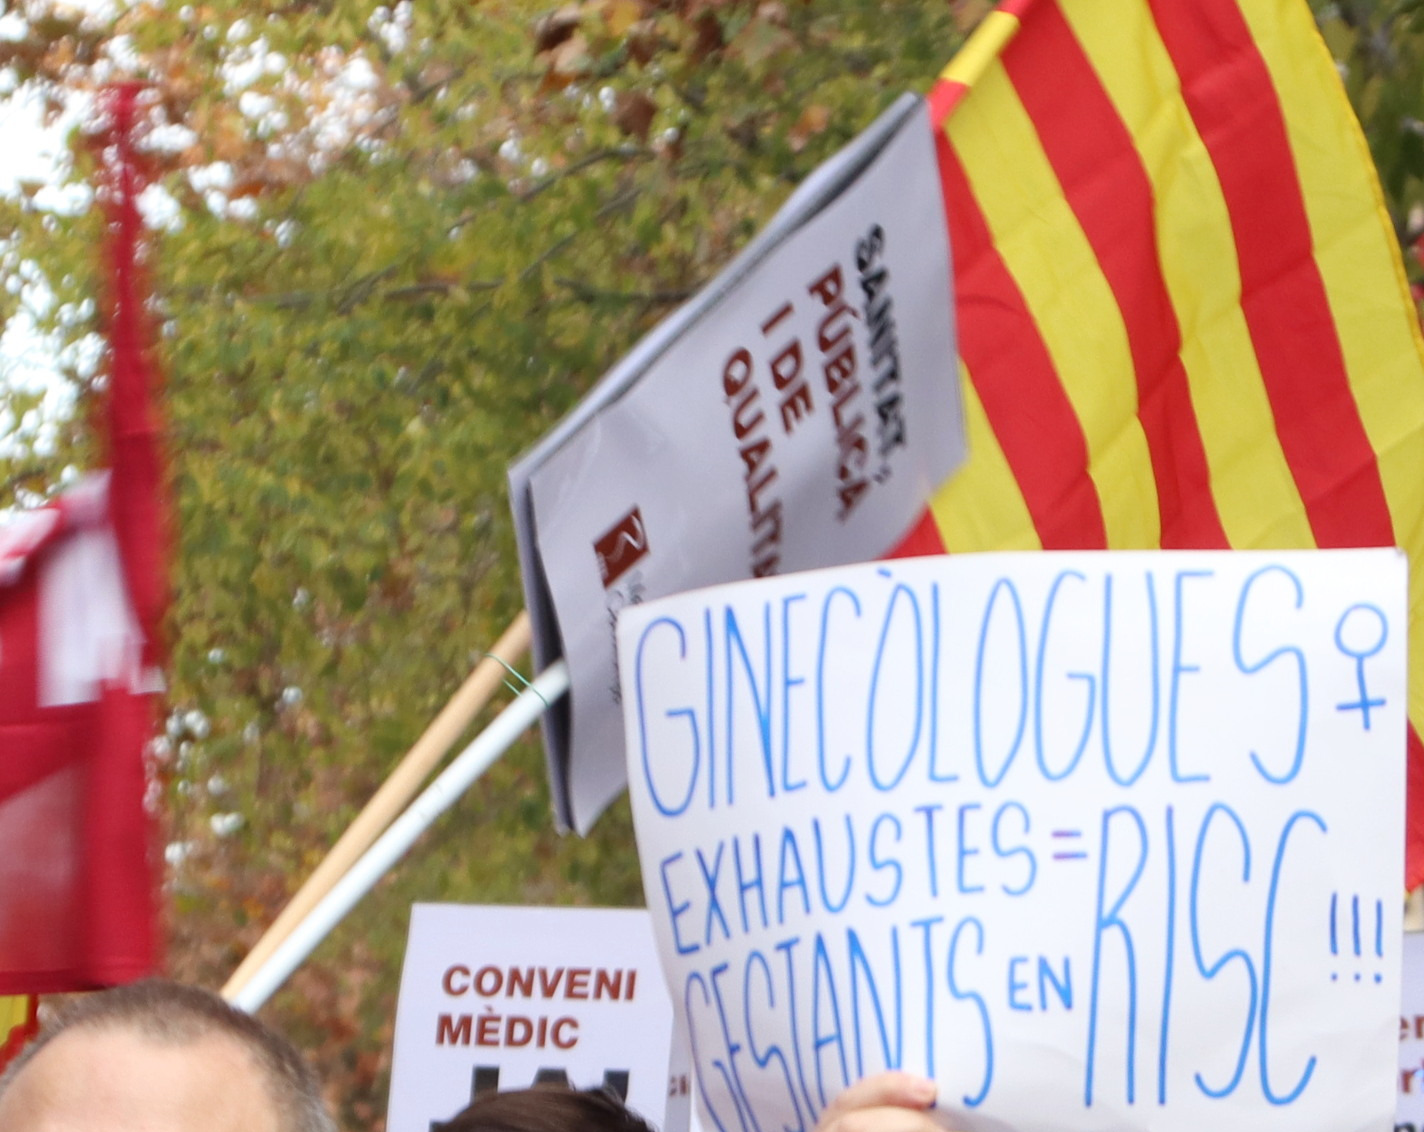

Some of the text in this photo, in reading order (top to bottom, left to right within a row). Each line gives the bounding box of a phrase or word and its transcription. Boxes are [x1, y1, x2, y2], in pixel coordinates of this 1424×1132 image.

[761, 303, 815, 435] I DE
[808, 264, 871, 522] PÚBLICA
[634, 564, 1309, 817] GINECÒLOGUES
[435, 1006, 580, 1049] MÈDIC
[442, 964, 637, 1002] CONVENI
[1007, 955, 1074, 1012] EN
